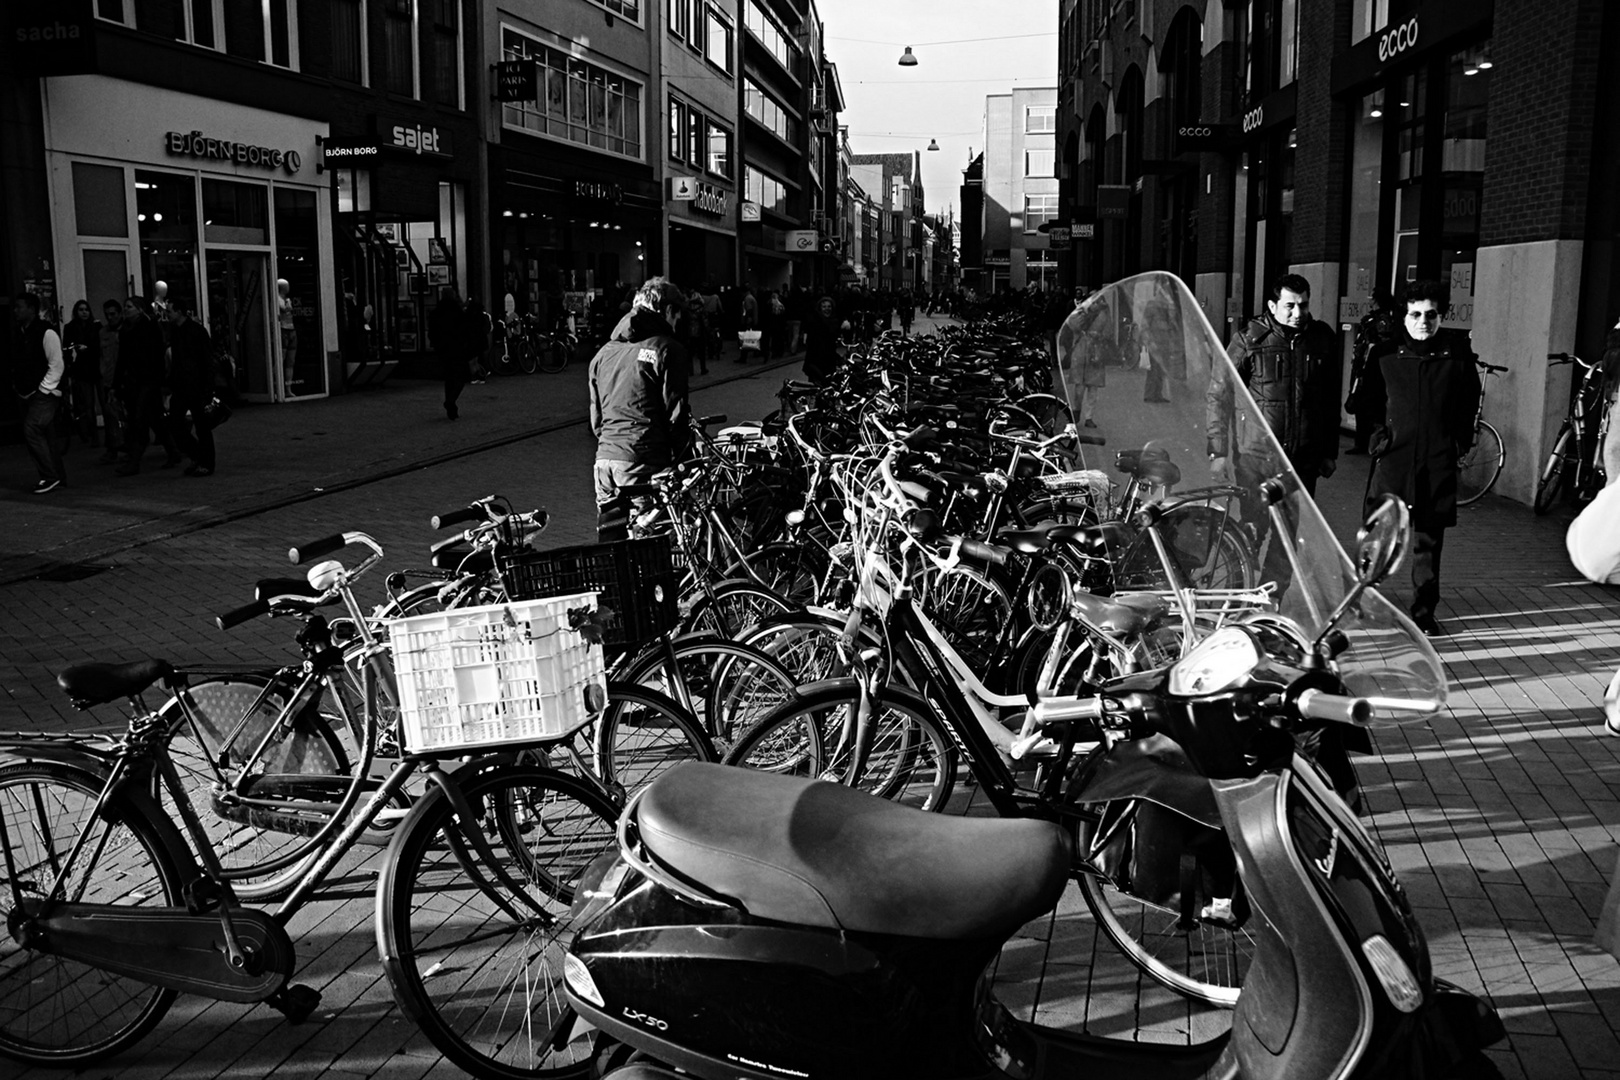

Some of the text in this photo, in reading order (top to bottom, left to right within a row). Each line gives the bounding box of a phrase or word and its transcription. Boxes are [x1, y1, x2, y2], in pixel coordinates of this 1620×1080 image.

[16, 20, 80, 42] sacha
[1378, 17, 1419, 62] ecco
[500, 75, 527, 85] PARIS
[505, 64, 521, 73] ICI
[1243, 105, 1264, 133] ecco
[392, 124, 440, 154] sajet
[1178, 127, 1212, 137] ecco
[166, 131, 283, 168] BJÖRN BORG
[325, 146, 377, 157] BJÖRN BORG
[694, 181, 728, 216] Rabobank
[1452, 270, 1470, 289] SALE
[928, 697, 976, 763] SPARTA
